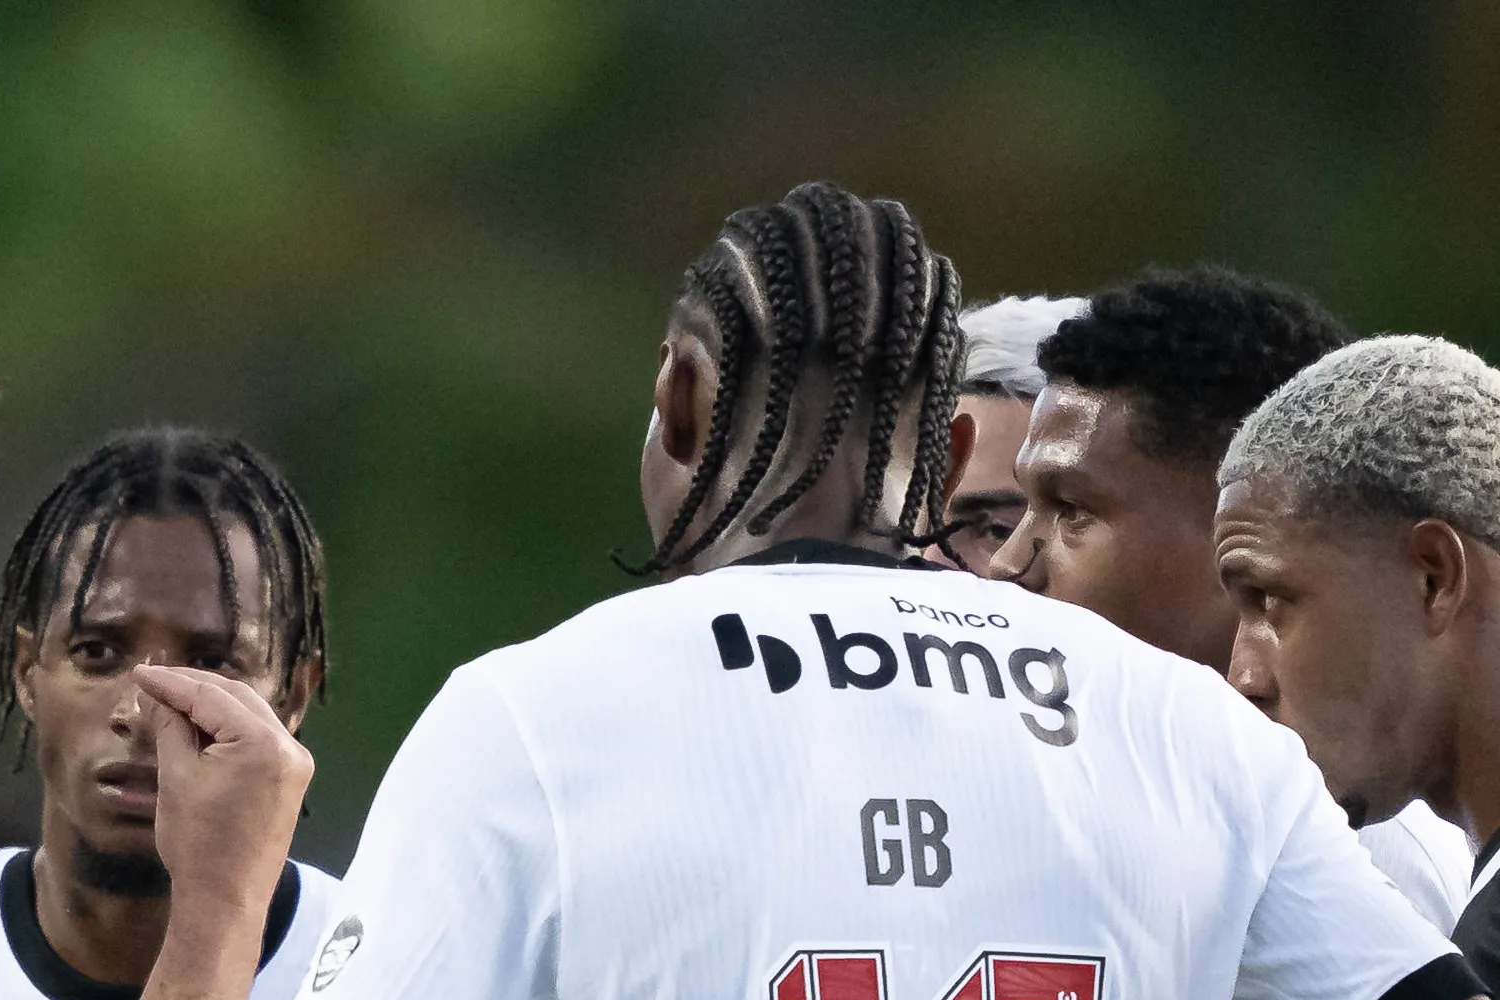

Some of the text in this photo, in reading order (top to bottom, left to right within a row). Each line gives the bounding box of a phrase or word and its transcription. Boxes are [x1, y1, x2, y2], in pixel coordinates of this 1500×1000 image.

[889, 596, 1010, 629] banco
[809, 613, 1079, 747] bmg
[860, 798, 953, 888] GB
